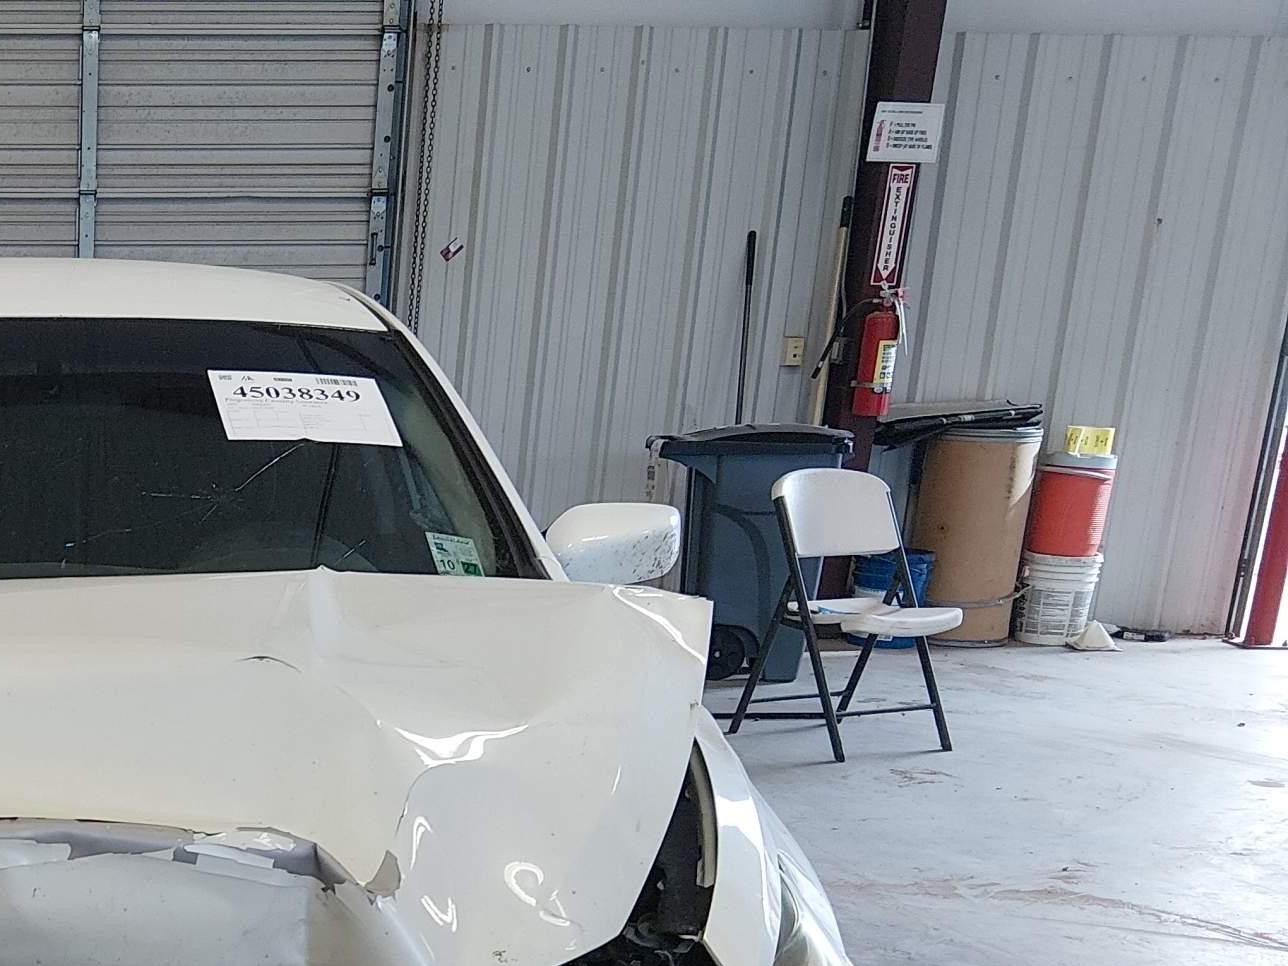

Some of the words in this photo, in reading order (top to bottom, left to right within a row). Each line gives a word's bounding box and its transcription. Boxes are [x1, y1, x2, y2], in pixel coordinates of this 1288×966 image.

[892, 173, 910, 184] FIRE
[882, 186, 903, 272] EXTINGUISHER
[232, 385, 361, 403] 45038349
[439, 559, 456, 571] 10
[464, 562, 479, 575] 27
